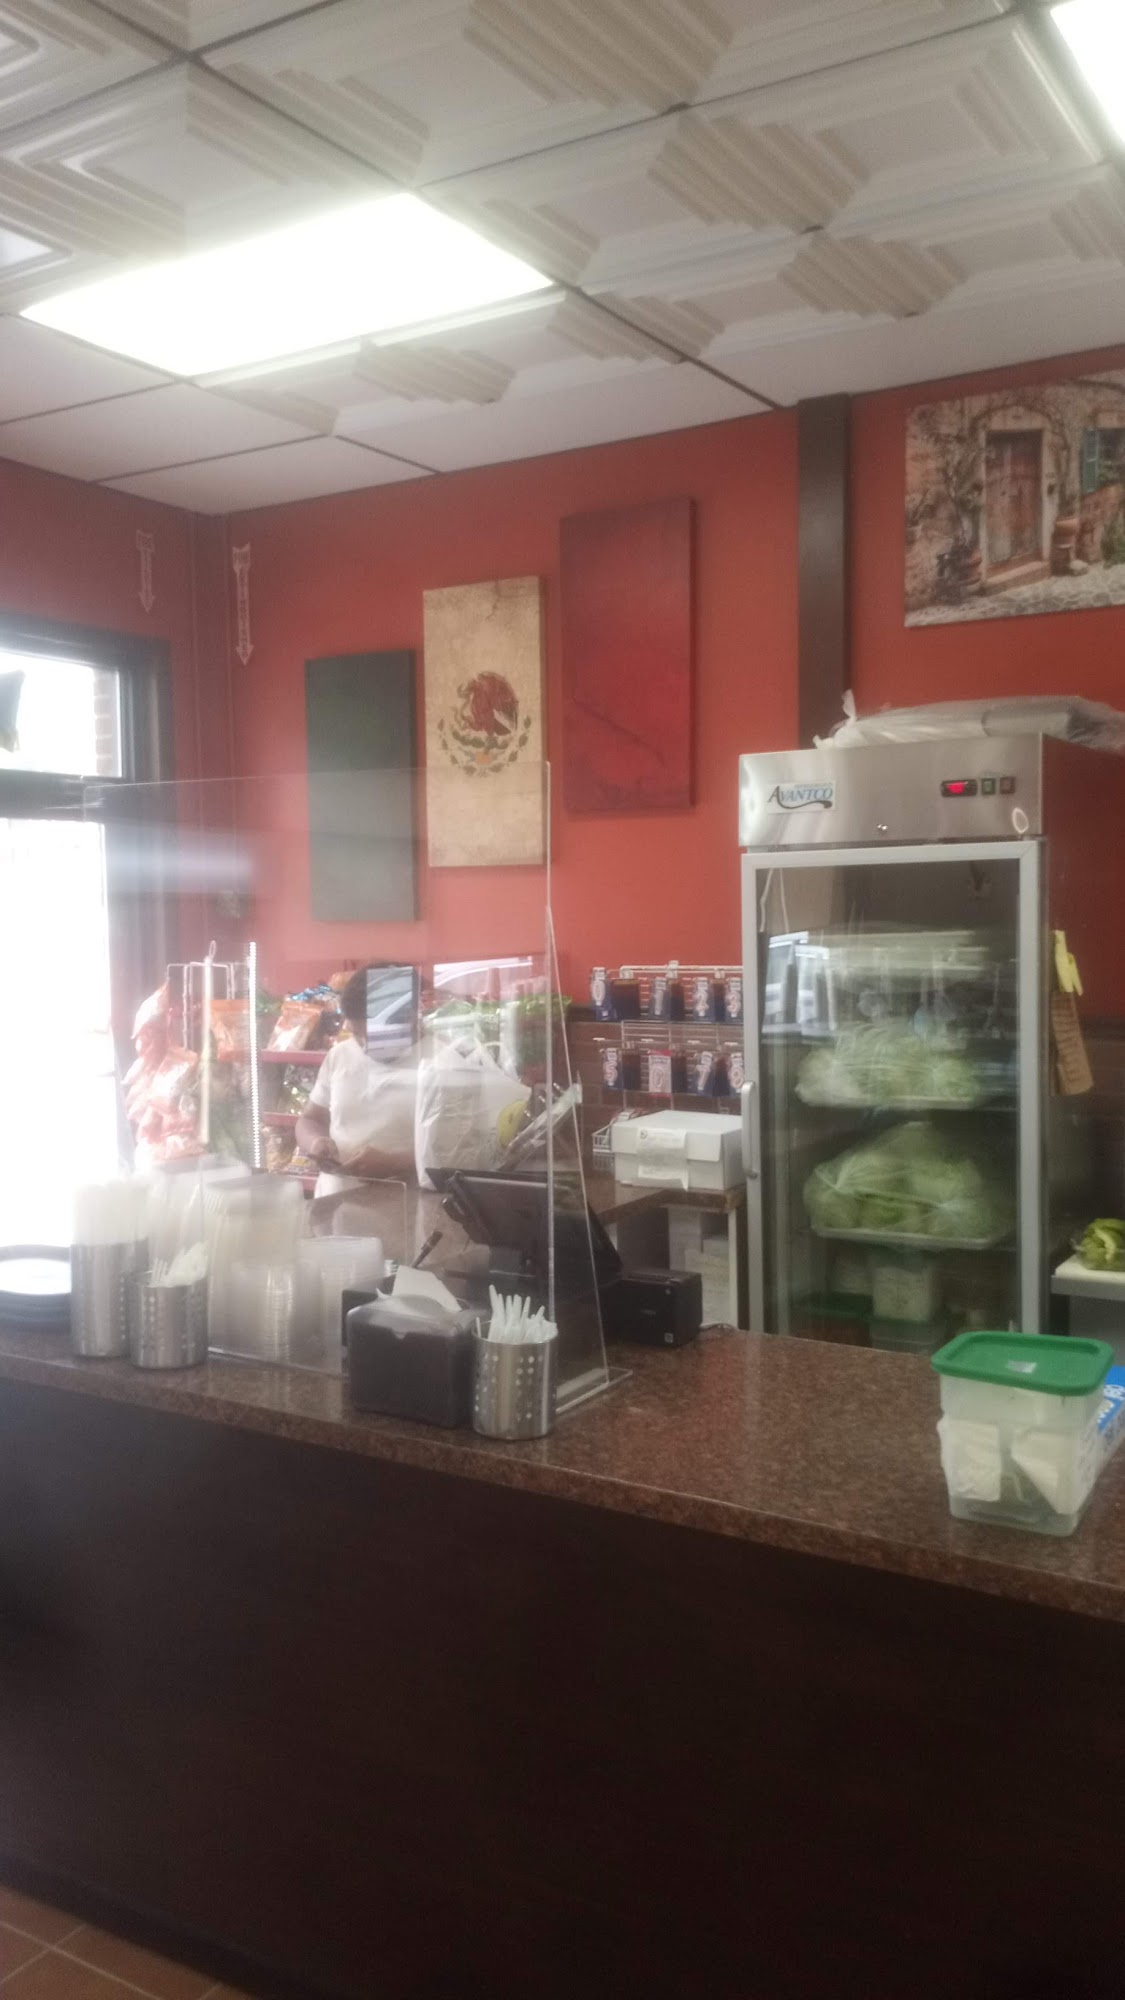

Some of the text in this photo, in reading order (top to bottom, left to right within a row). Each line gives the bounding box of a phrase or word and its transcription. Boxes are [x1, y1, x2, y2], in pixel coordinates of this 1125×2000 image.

[768, 785, 833, 808] AVANTCO
[693, 990, 709, 1013] 2
[726, 990, 741, 1013] 3
[603, 1061, 618, 1083] 5
[695, 1064, 710, 1089] 7
[729, 1067, 744, 1088] 8
